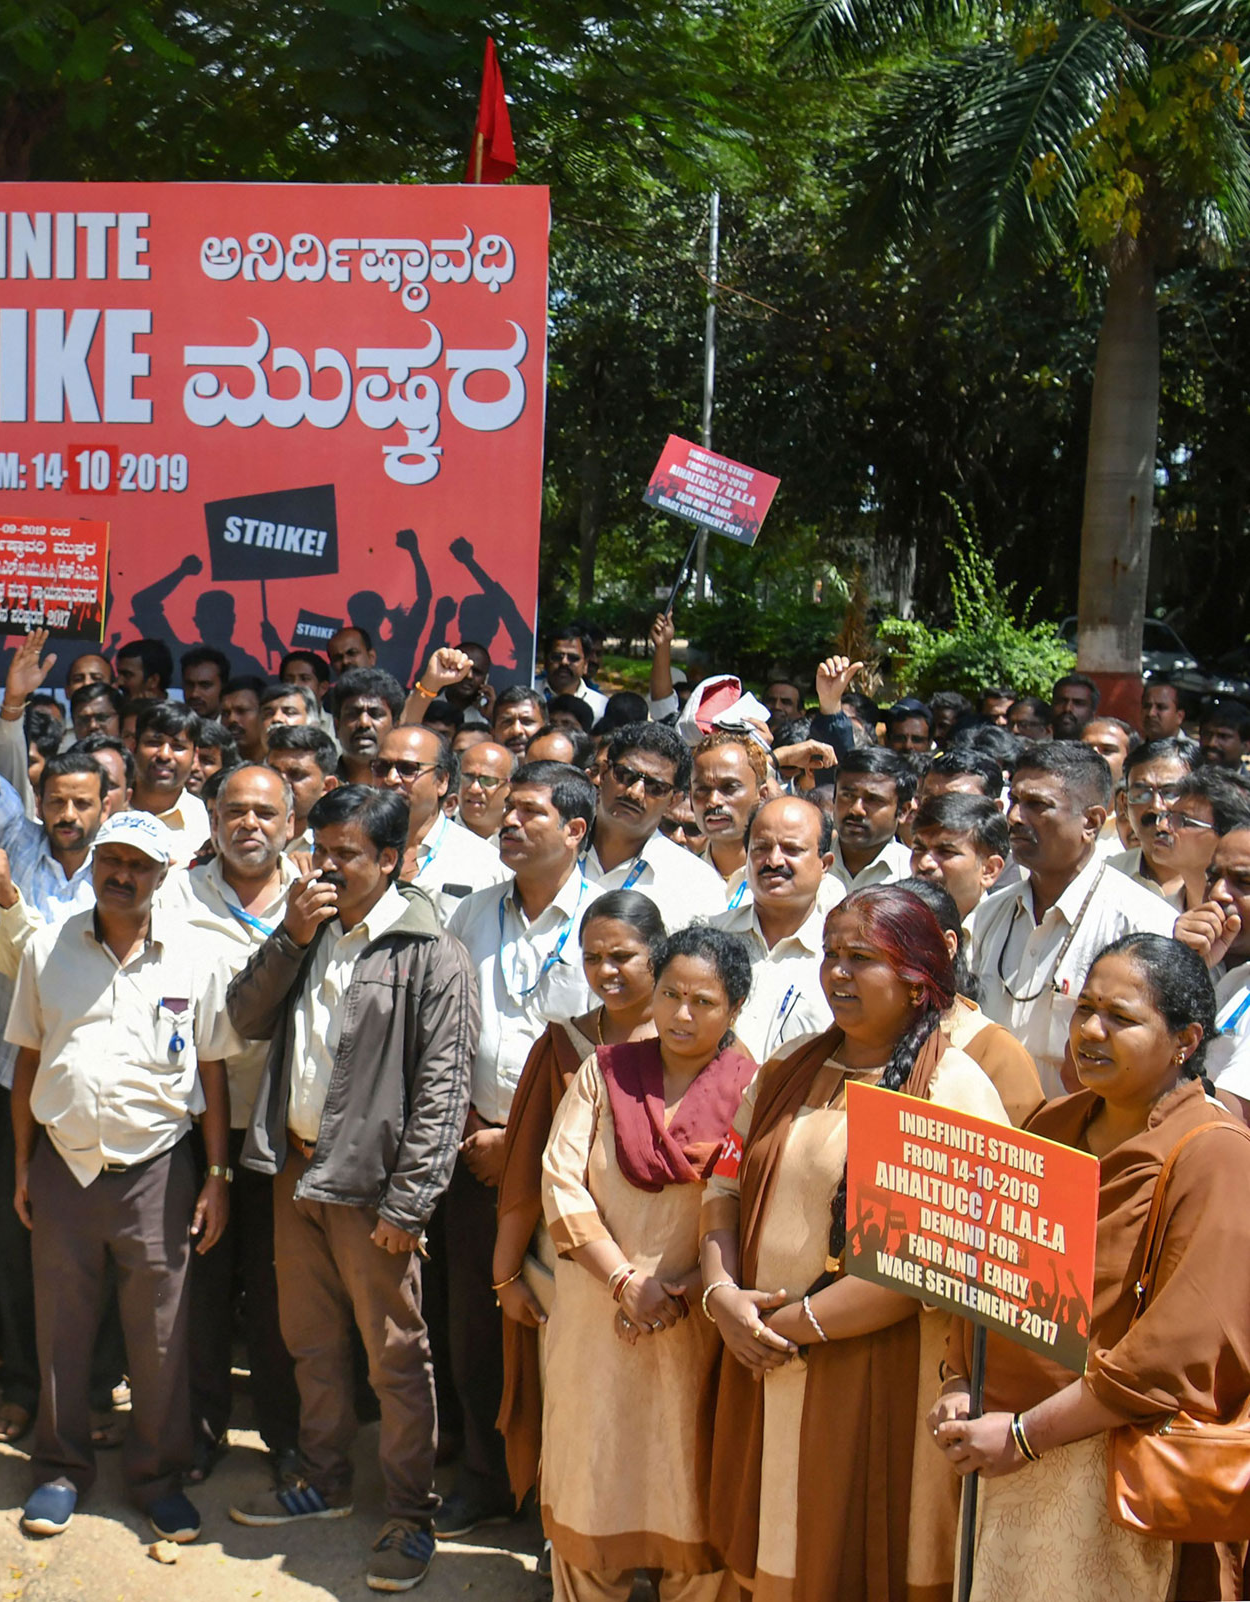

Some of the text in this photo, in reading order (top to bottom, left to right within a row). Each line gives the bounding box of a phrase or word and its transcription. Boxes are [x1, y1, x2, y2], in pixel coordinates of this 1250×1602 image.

[183, 317, 528, 485] ಮುಷ್ಕರ
[686, 459, 708, 476] FROM
[688, 448, 755, 481] INDEFINITE STRIKE
[675, 491, 733, 520] FAIR AND EARLY
[685, 483, 733, 508] DEMAND FOR
[719, 484, 726, 495] /
[224, 516, 327, 557] STRIKE!
[658, 495, 744, 537] WAGE SETTLEMENT 2017
[46, 609, 71, 627] 2017
[899, 1110, 1045, 1178] INDEFINITE STRIKE
[903, 1141, 1040, 1208] FROM 14-10-2019
[875, 1160, 1066, 1254] AIHALTUCC / H.A.E.A
[920, 1206, 1019, 1264] DEMAND FOR
[909, 1233, 1030, 1300] FAIR AND EARLY
[876, 1251, 1059, 1346] WAGE SETTLEMENT 2017
